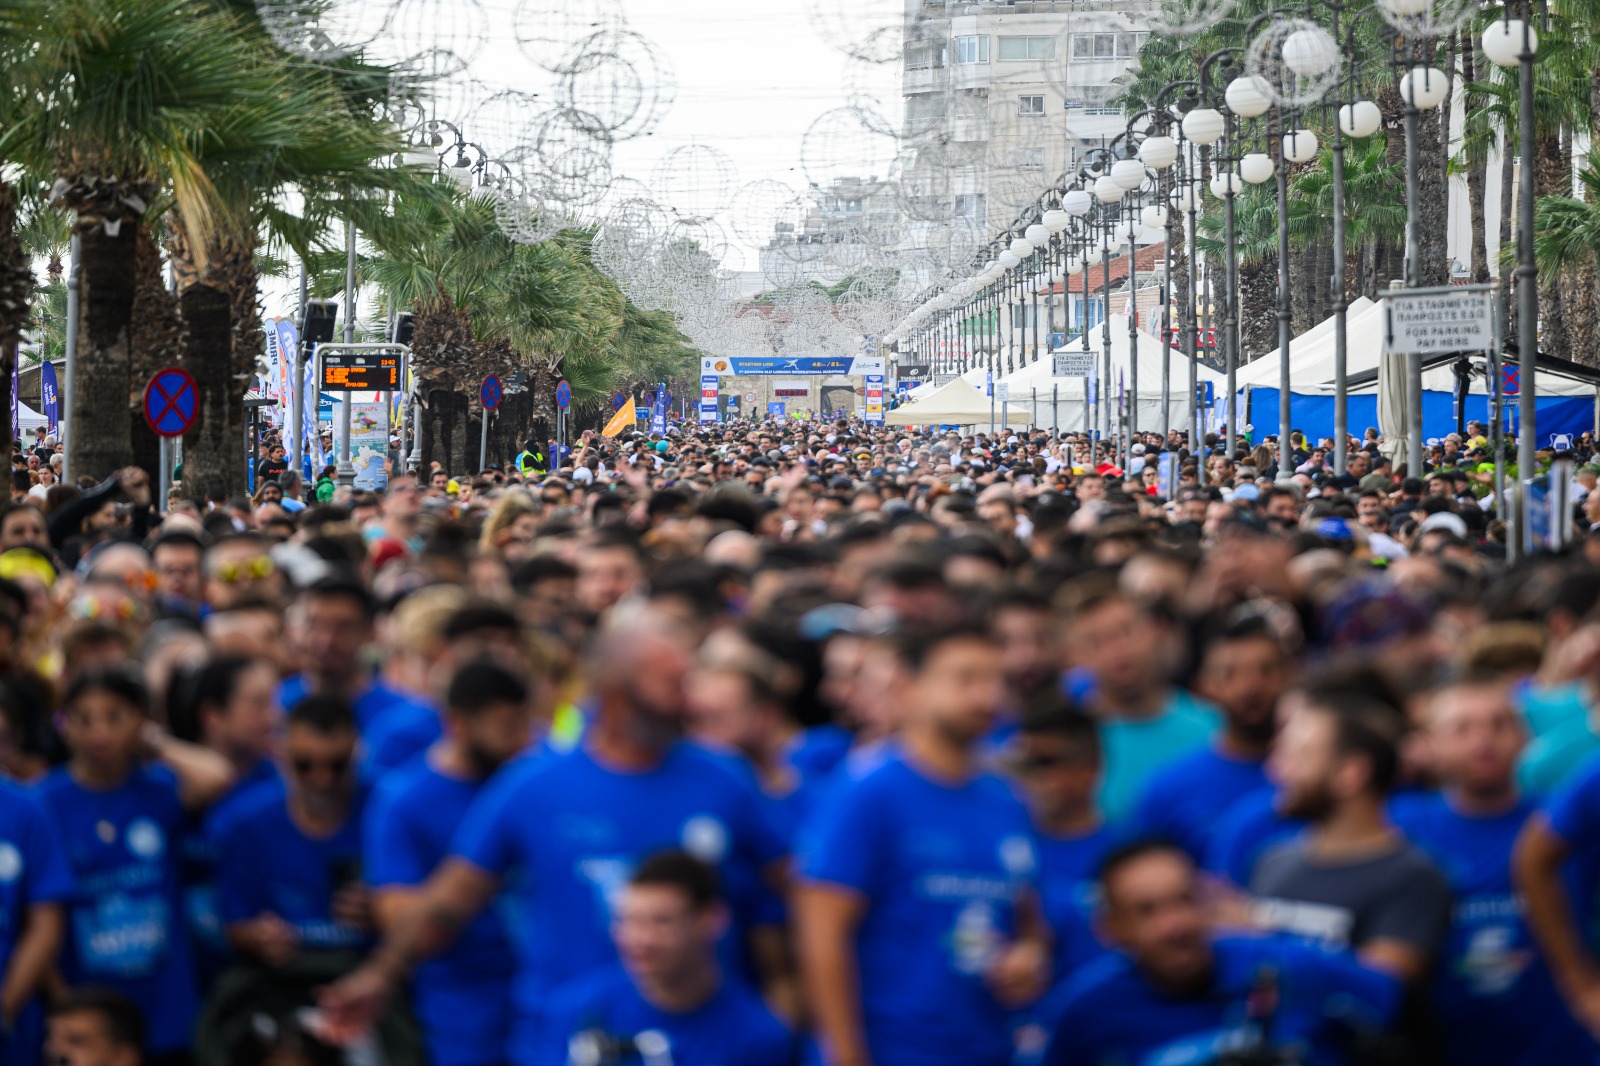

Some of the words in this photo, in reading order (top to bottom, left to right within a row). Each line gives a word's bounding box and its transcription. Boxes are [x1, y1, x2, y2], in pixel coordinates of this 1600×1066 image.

[1395, 301, 1413, 311] ΓΙΑ
[1405, 327, 1427, 338] FOR
[1431, 325, 1480, 335] PARKING
[1416, 338, 1437, 348] PAY
[1439, 337, 1469, 347] HERE
